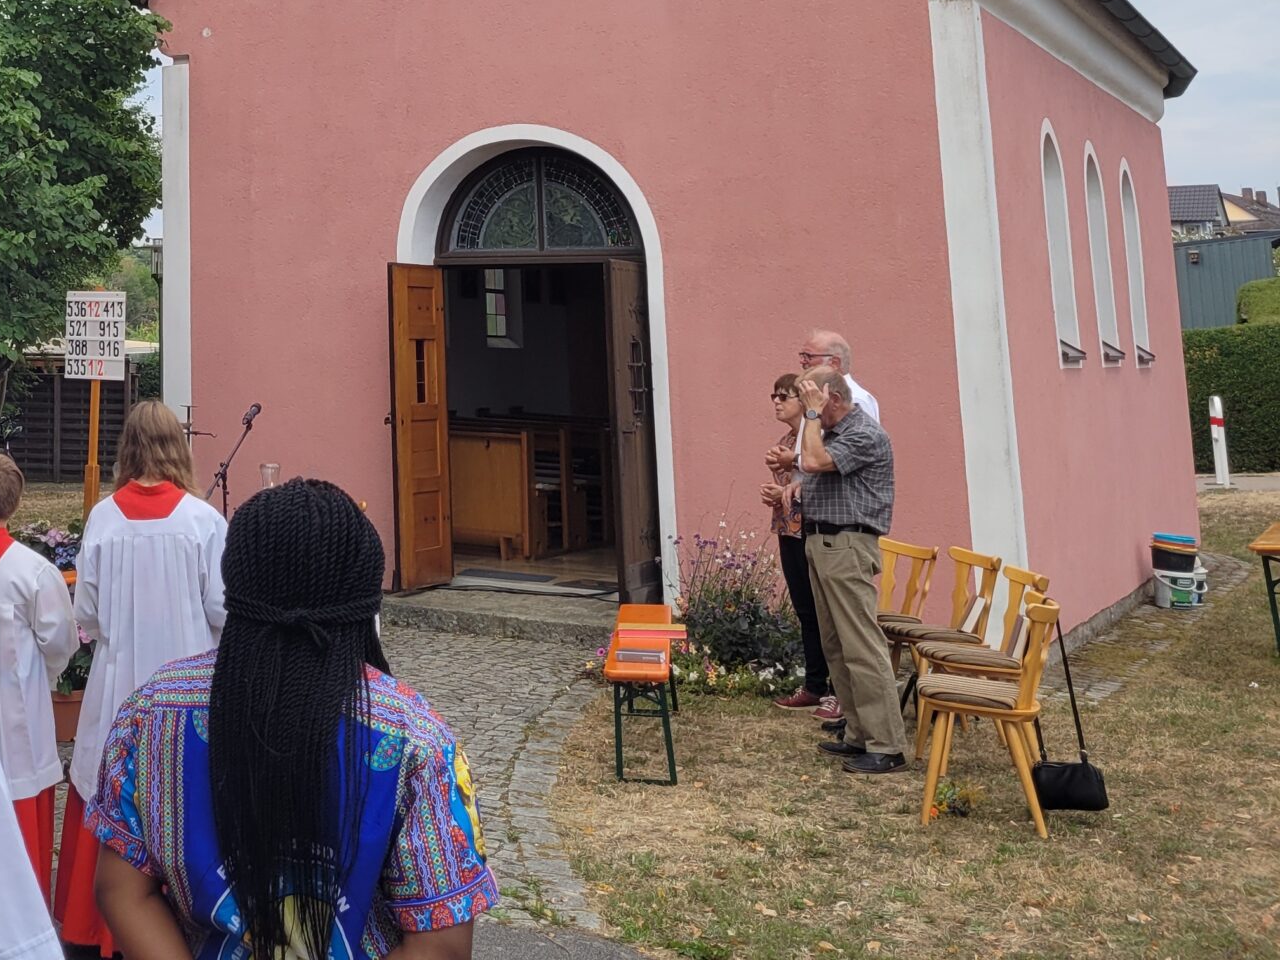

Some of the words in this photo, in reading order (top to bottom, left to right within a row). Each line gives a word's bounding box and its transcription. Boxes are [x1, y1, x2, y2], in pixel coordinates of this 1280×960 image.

[103, 301, 123, 318] 413
[69, 320, 87, 337] 521
[99, 321, 119, 338] 915
[68, 340, 88, 356] 388
[99, 340, 120, 357] 916
[67, 359, 86, 376] 535
